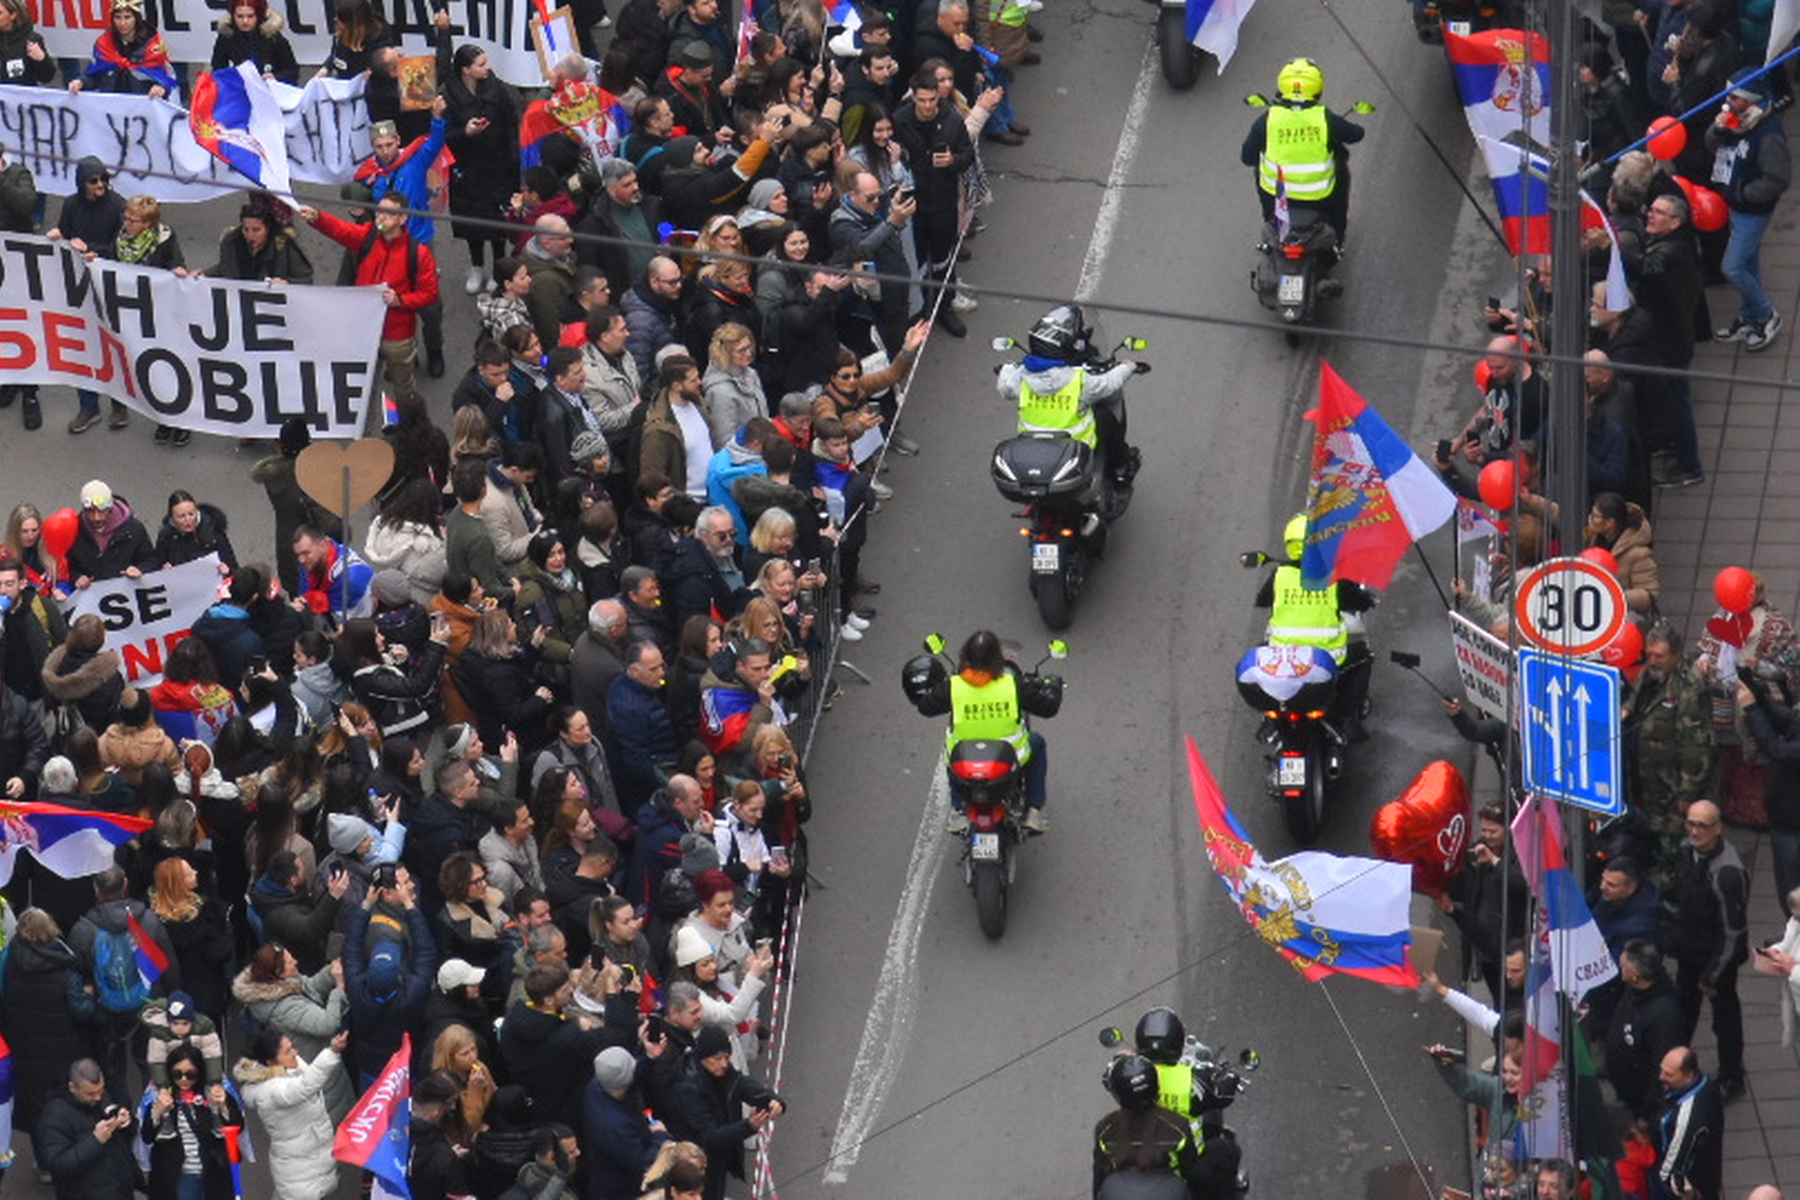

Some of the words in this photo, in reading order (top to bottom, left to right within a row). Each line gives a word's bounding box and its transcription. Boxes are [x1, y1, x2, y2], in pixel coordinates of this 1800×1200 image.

[106, 112, 150, 181] УЗ
[188, 286, 296, 353] ЈЕ
[97, 583, 173, 633] SE
[1537, 583, 1603, 633] 30
